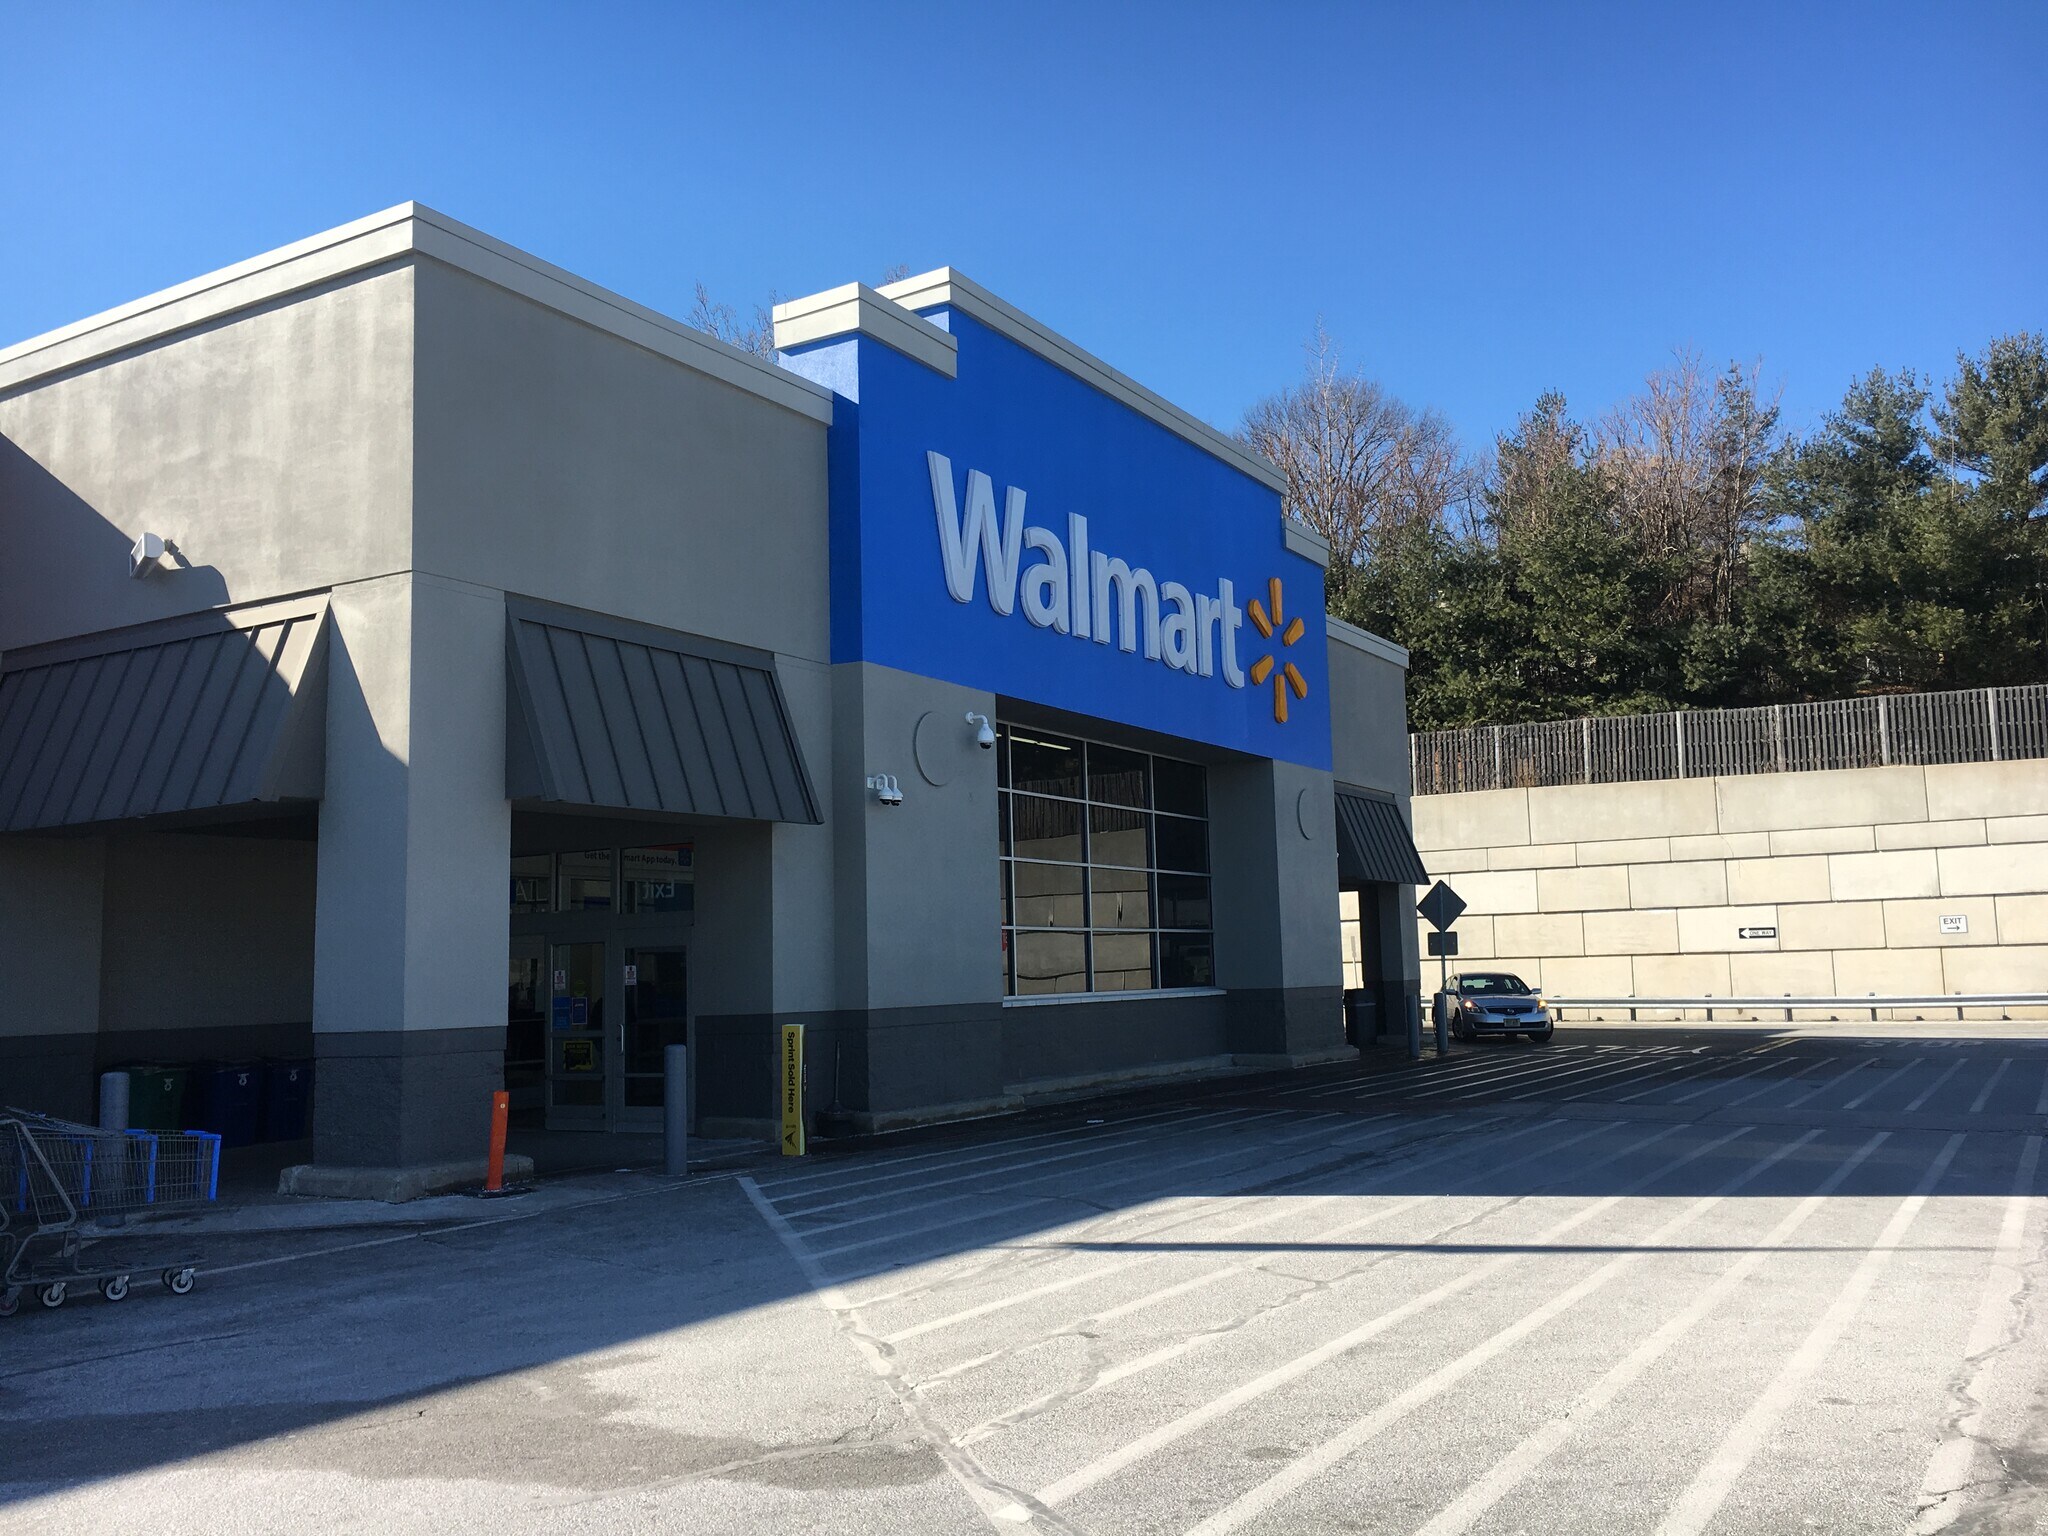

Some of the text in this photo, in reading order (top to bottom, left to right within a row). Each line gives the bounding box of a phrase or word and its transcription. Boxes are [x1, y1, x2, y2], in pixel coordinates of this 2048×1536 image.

[926, 449, 1245, 688] Walmart
[641, 854, 656, 865] App
[1943, 917, 1962, 925] EXIT
[786, 1031, 795, 1113] Sprint Sold Here
